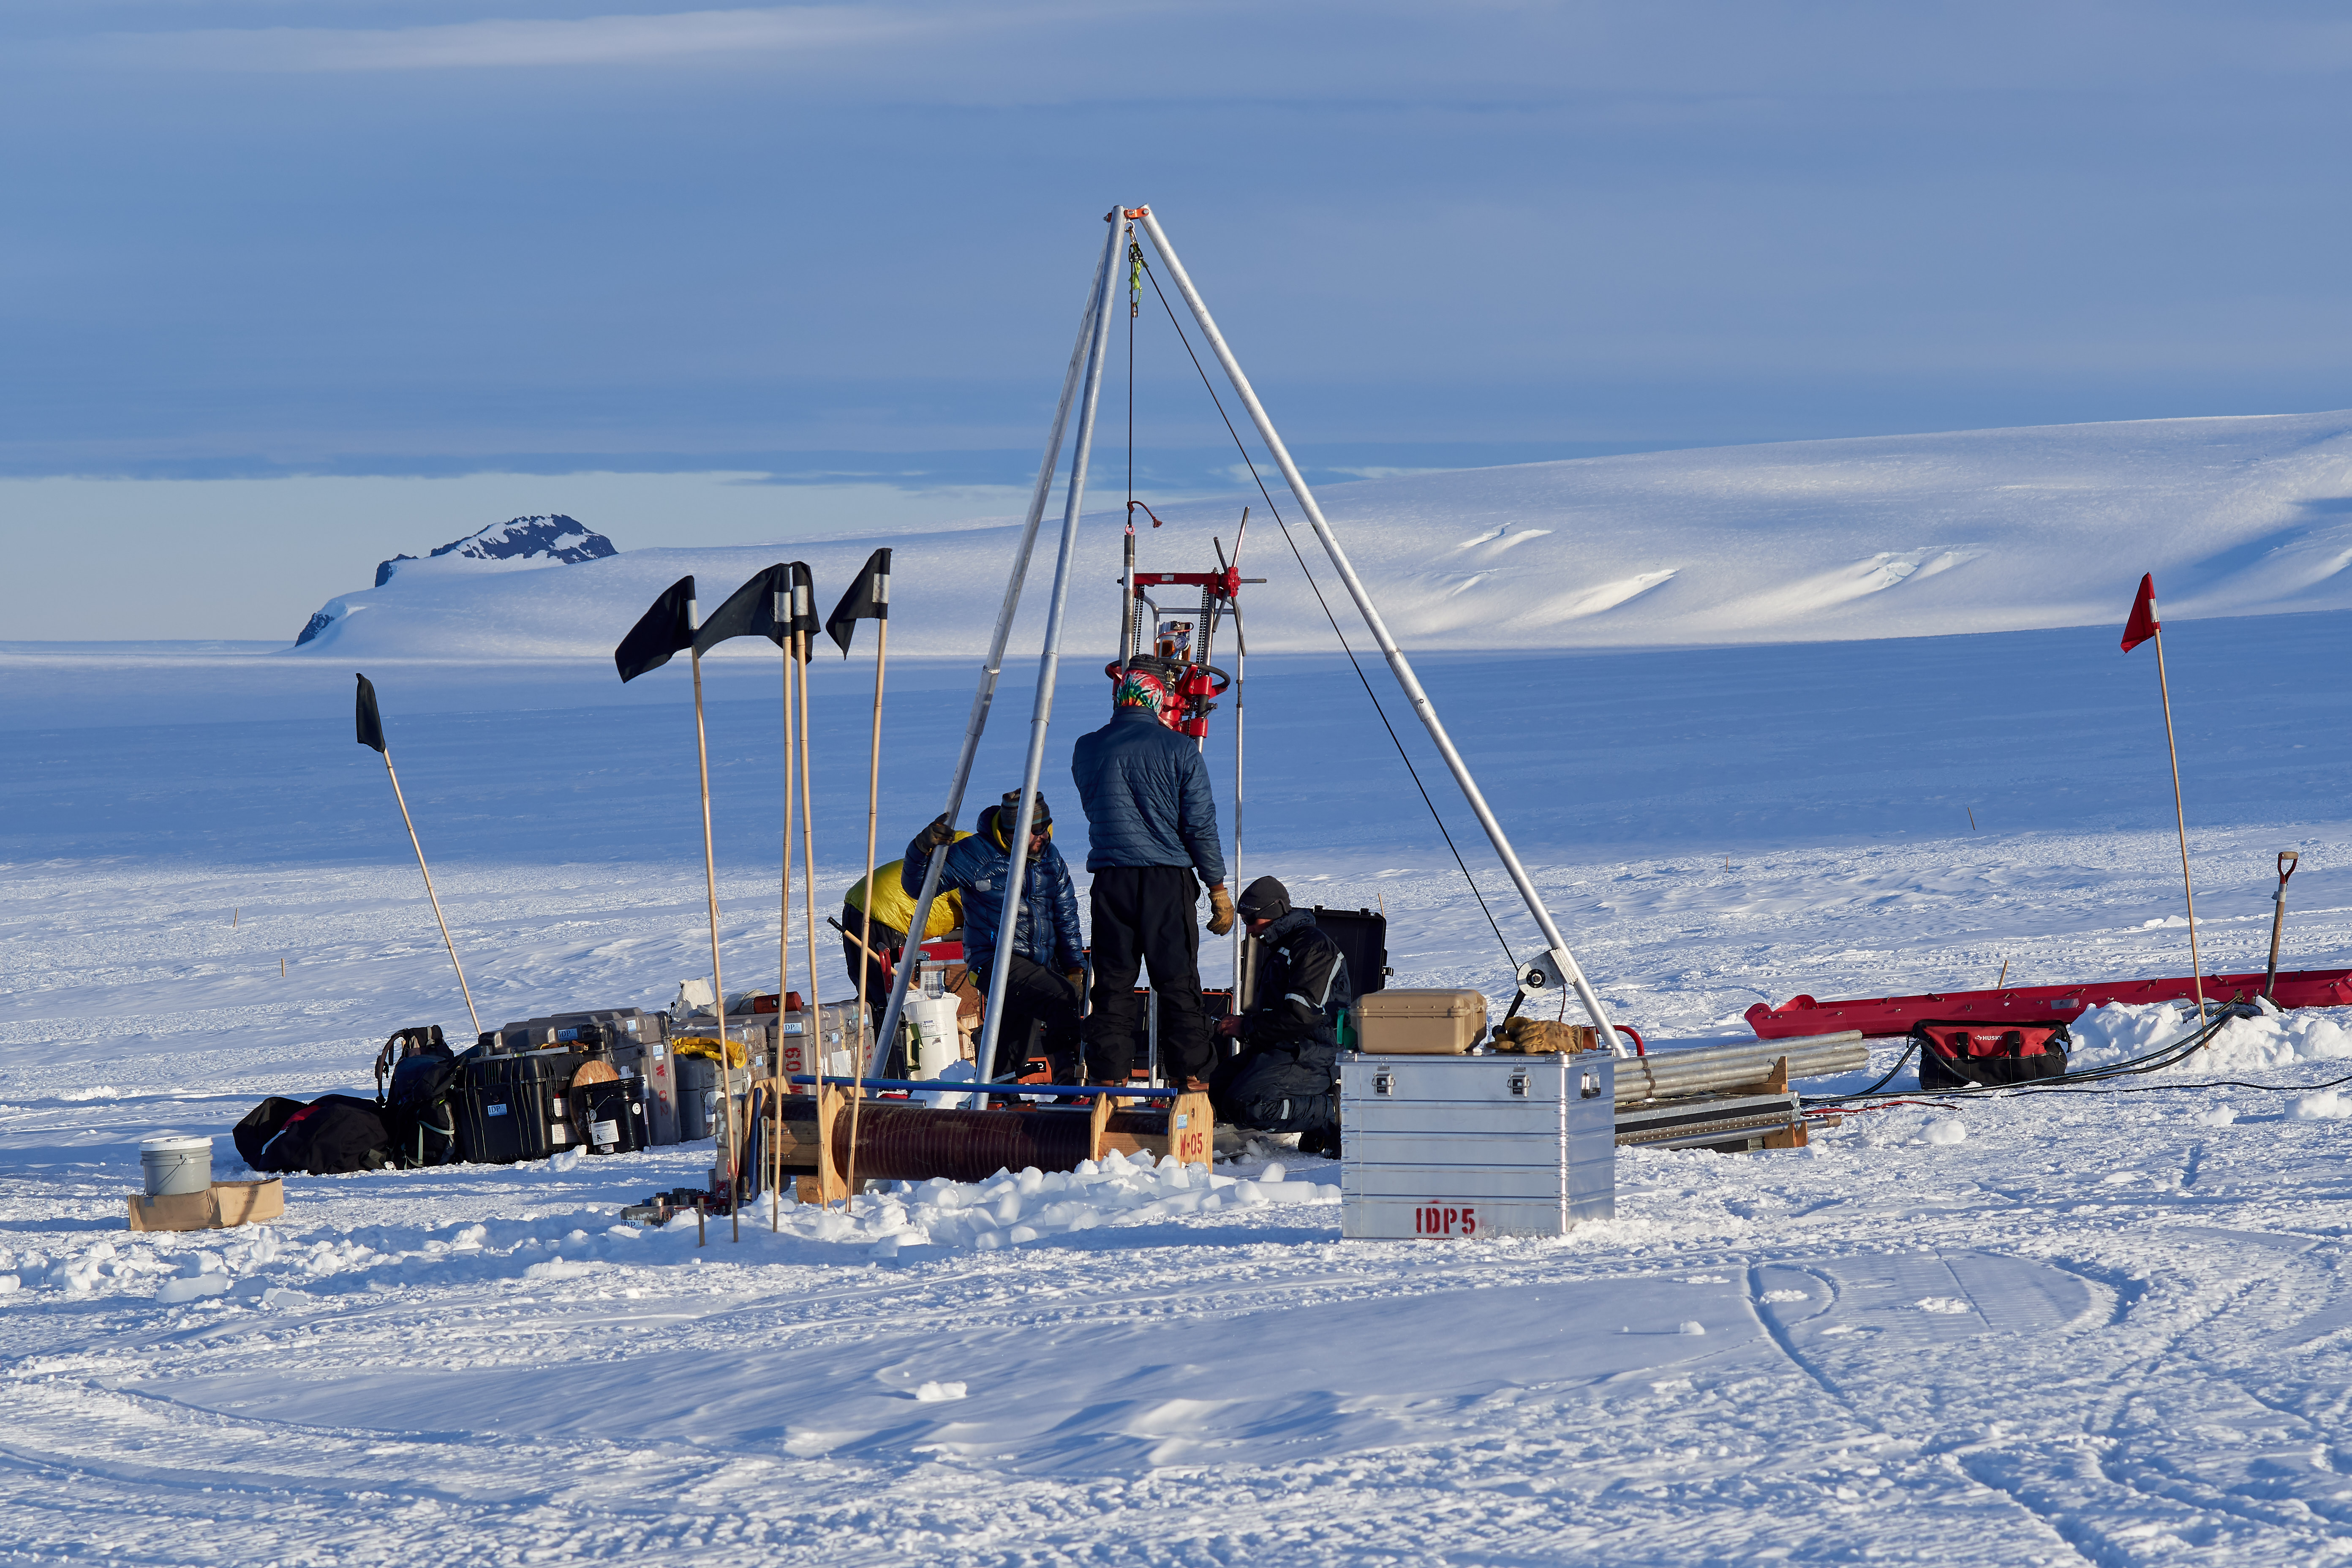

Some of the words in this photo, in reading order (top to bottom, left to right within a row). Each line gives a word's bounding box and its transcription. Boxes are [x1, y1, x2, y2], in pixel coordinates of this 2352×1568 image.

[656, 1064, 665, 1077] W
[597, 1134, 603, 1142] R
[1180, 1132, 1203, 1157] W-05
[1497, 1227, 1550, 1238] ZARGES
